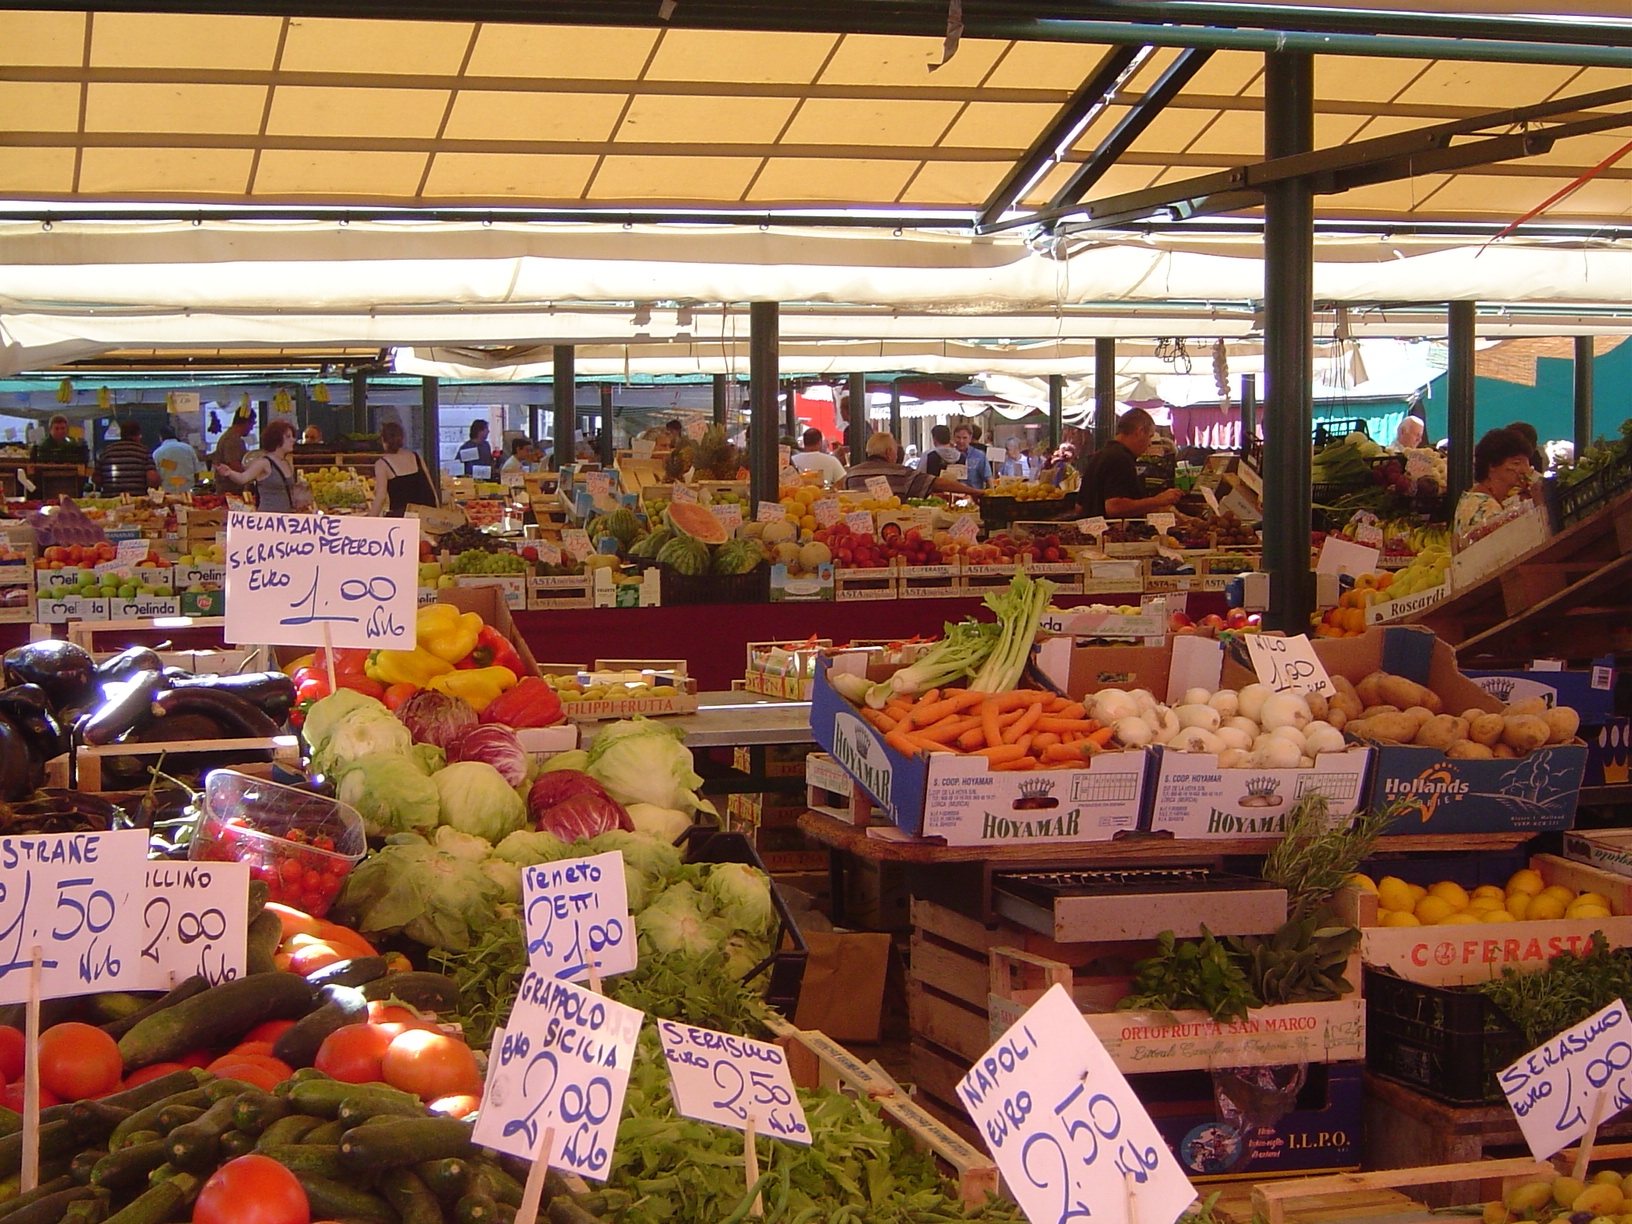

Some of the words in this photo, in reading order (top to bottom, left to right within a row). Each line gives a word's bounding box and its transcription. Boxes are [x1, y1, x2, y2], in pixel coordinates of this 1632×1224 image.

[231, 513, 341, 537] MELANZANE
[319, 526, 405, 558] PEPERONI
[280, 565, 397, 625] 1.00
[1205, 579, 1226, 587] ASTA
[123, 603, 175, 615] Melinda
[1391, 588, 1445, 617] Roscardi
[1255, 634, 1286, 653] KILO
[567, 702, 614, 715] FILIPPI
[620, 699, 674, 711] FRUTTA
[834, 723, 894, 807] HOYAMAR
[1192, 774, 1222, 783] HOYAMAR
[962, 777, 994, 786] HOYAMAR
[1385, 778, 1470, 794] Hollands
[981, 809, 1081, 840] HOYAMAR
[1207, 807, 1290, 833] HOYAMA
[140, 896, 227, 964] 2.00
[521, 971, 606, 1031] GRAPPOLO
[1228, 1018, 1260, 1034] SAN
[1265, 1016, 1317, 1033] MARCO
[543, 1017, 618, 1070] SICILIA
[962, 1025, 1038, 1110] NAPOLI
[502, 1050, 613, 1151] 2.00
[713, 1060, 791, 1120] 2.50
[986, 1090, 1032, 1148] EURO
[1021, 1083, 1122, 1224] 2.50
[1289, 1131, 1351, 1150] I.L.P.O.
